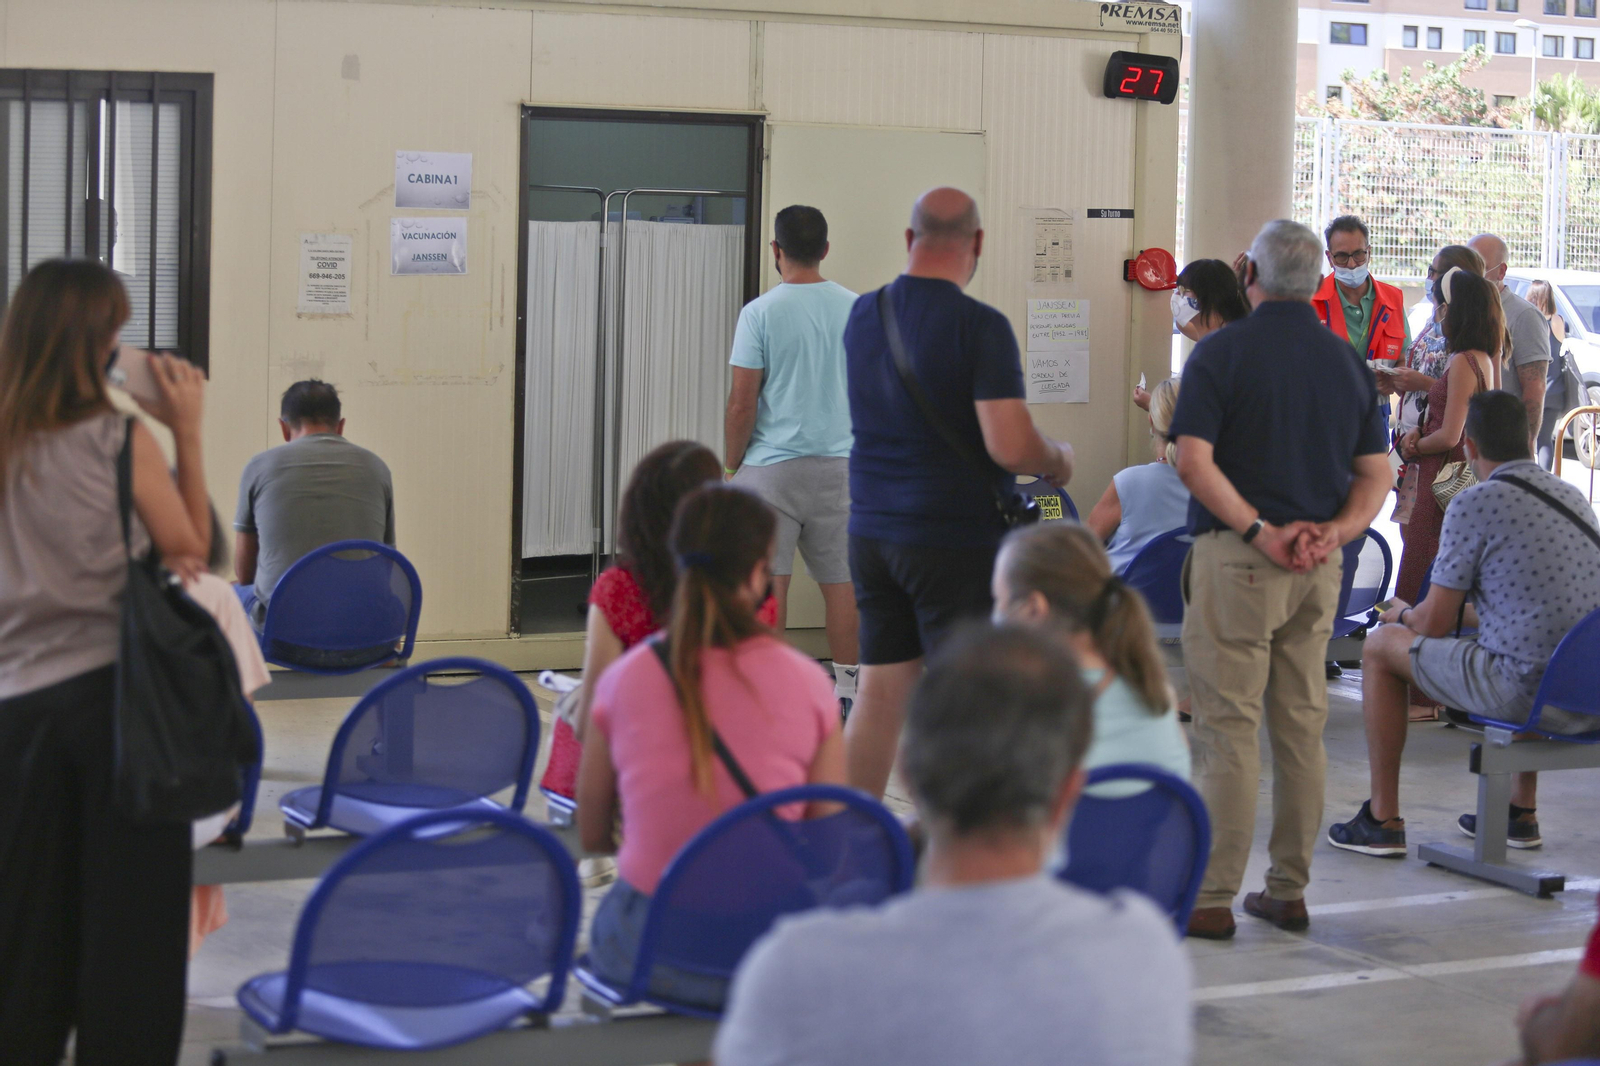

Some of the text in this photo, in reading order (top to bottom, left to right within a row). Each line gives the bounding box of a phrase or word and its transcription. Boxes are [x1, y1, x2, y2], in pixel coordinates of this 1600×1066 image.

[1108, 4, 1179, 22] REMSA
[1126, 20, 1179, 28] www.remsa.net
[1120, 66, 1164, 94] 27
[1100, 209, 1108, 218] Su
[402, 231, 457, 240] VACUNACIÓN
[411, 253, 448, 262] JANSSEN
[317, 261, 337, 269] COVID
[1036, 300, 1076, 310] JANSSEN
[1032, 331, 1050, 339] ENTRE
[1031, 359, 1071, 369] VAMOS X
[1031, 370, 1068, 380] ORDEN DE
[1041, 381, 1071, 390] LLEGADA
